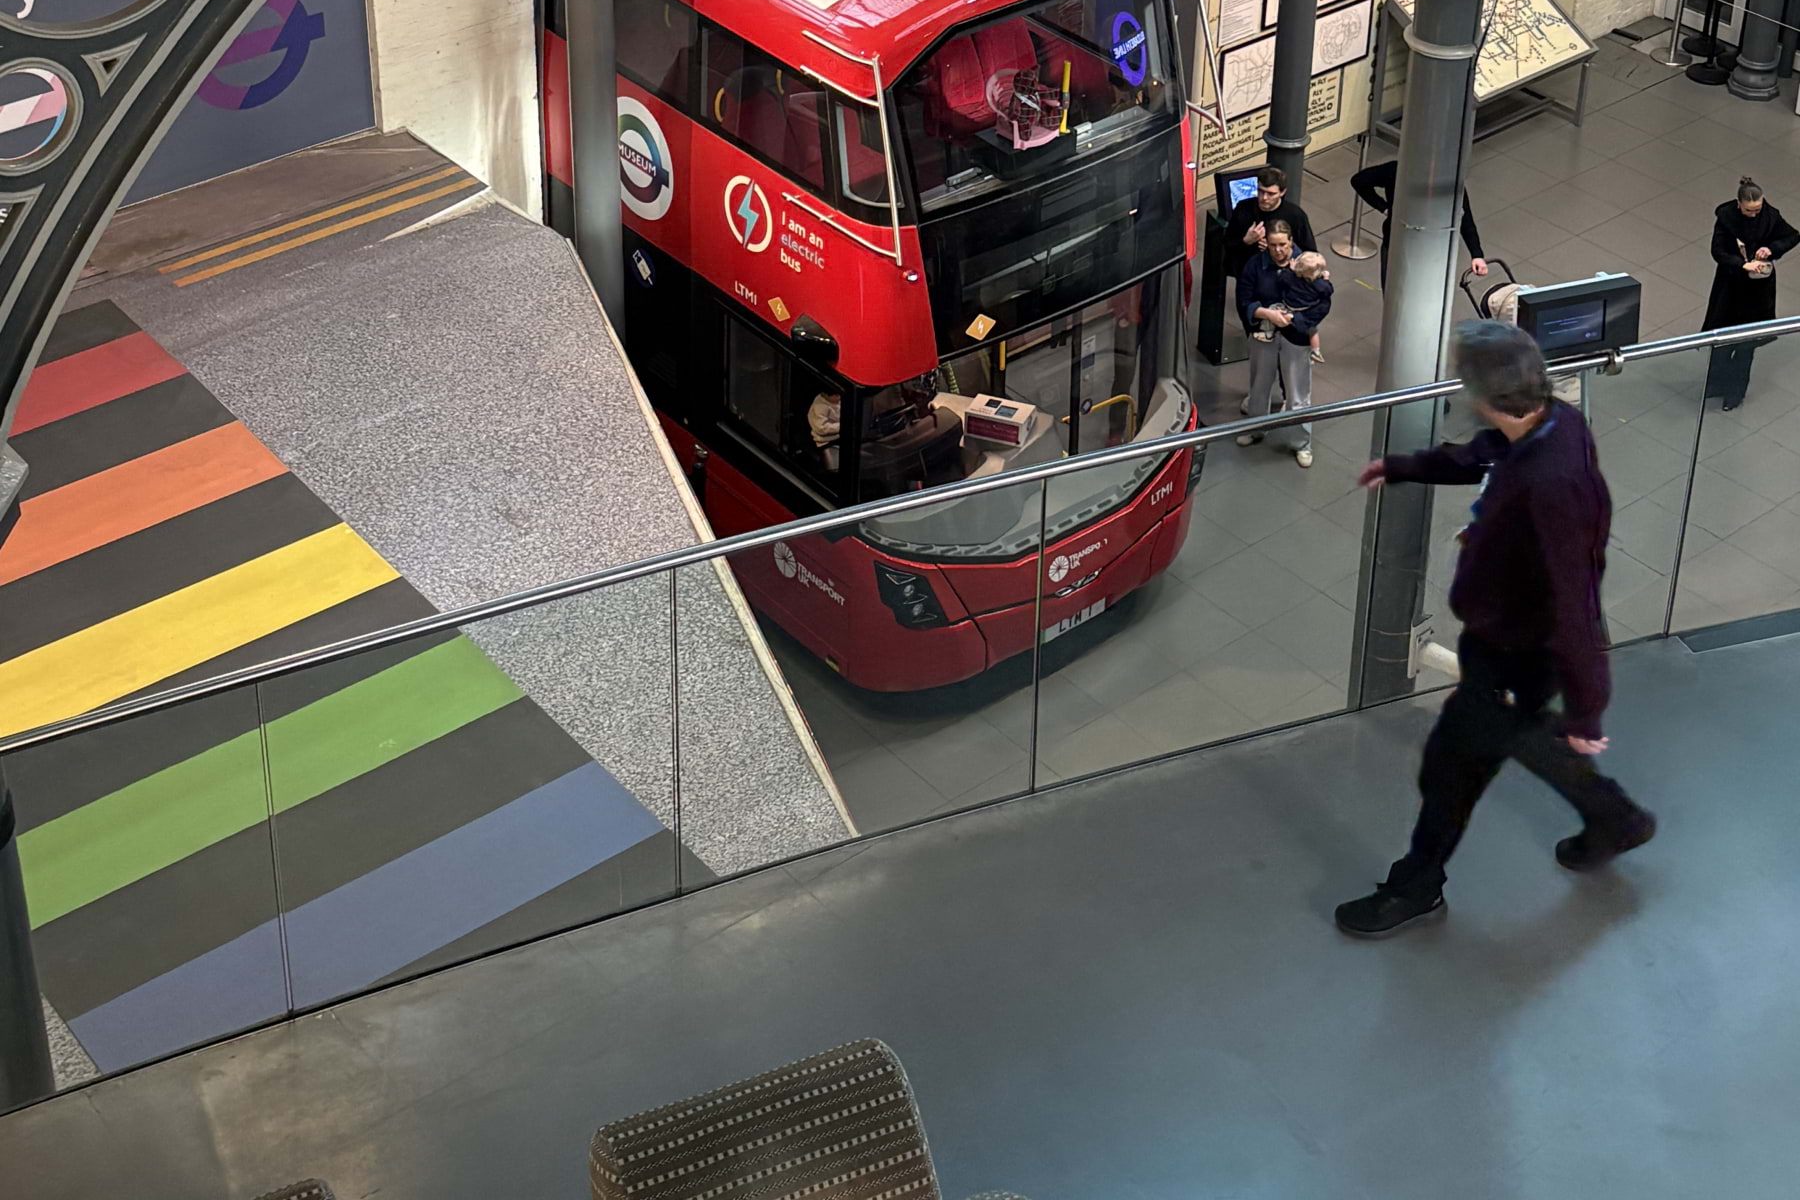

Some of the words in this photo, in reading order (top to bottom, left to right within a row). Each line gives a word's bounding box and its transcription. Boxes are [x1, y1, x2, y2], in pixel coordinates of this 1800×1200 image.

[781, 210, 786, 226] I
[788, 219, 806, 239] am
[809, 232, 824, 250] an
[780, 247, 802, 273] bus
[781, 233, 825, 270] electric
[1070, 557, 1081, 570] UK
[797, 561, 846, 607] TRANSPORT
